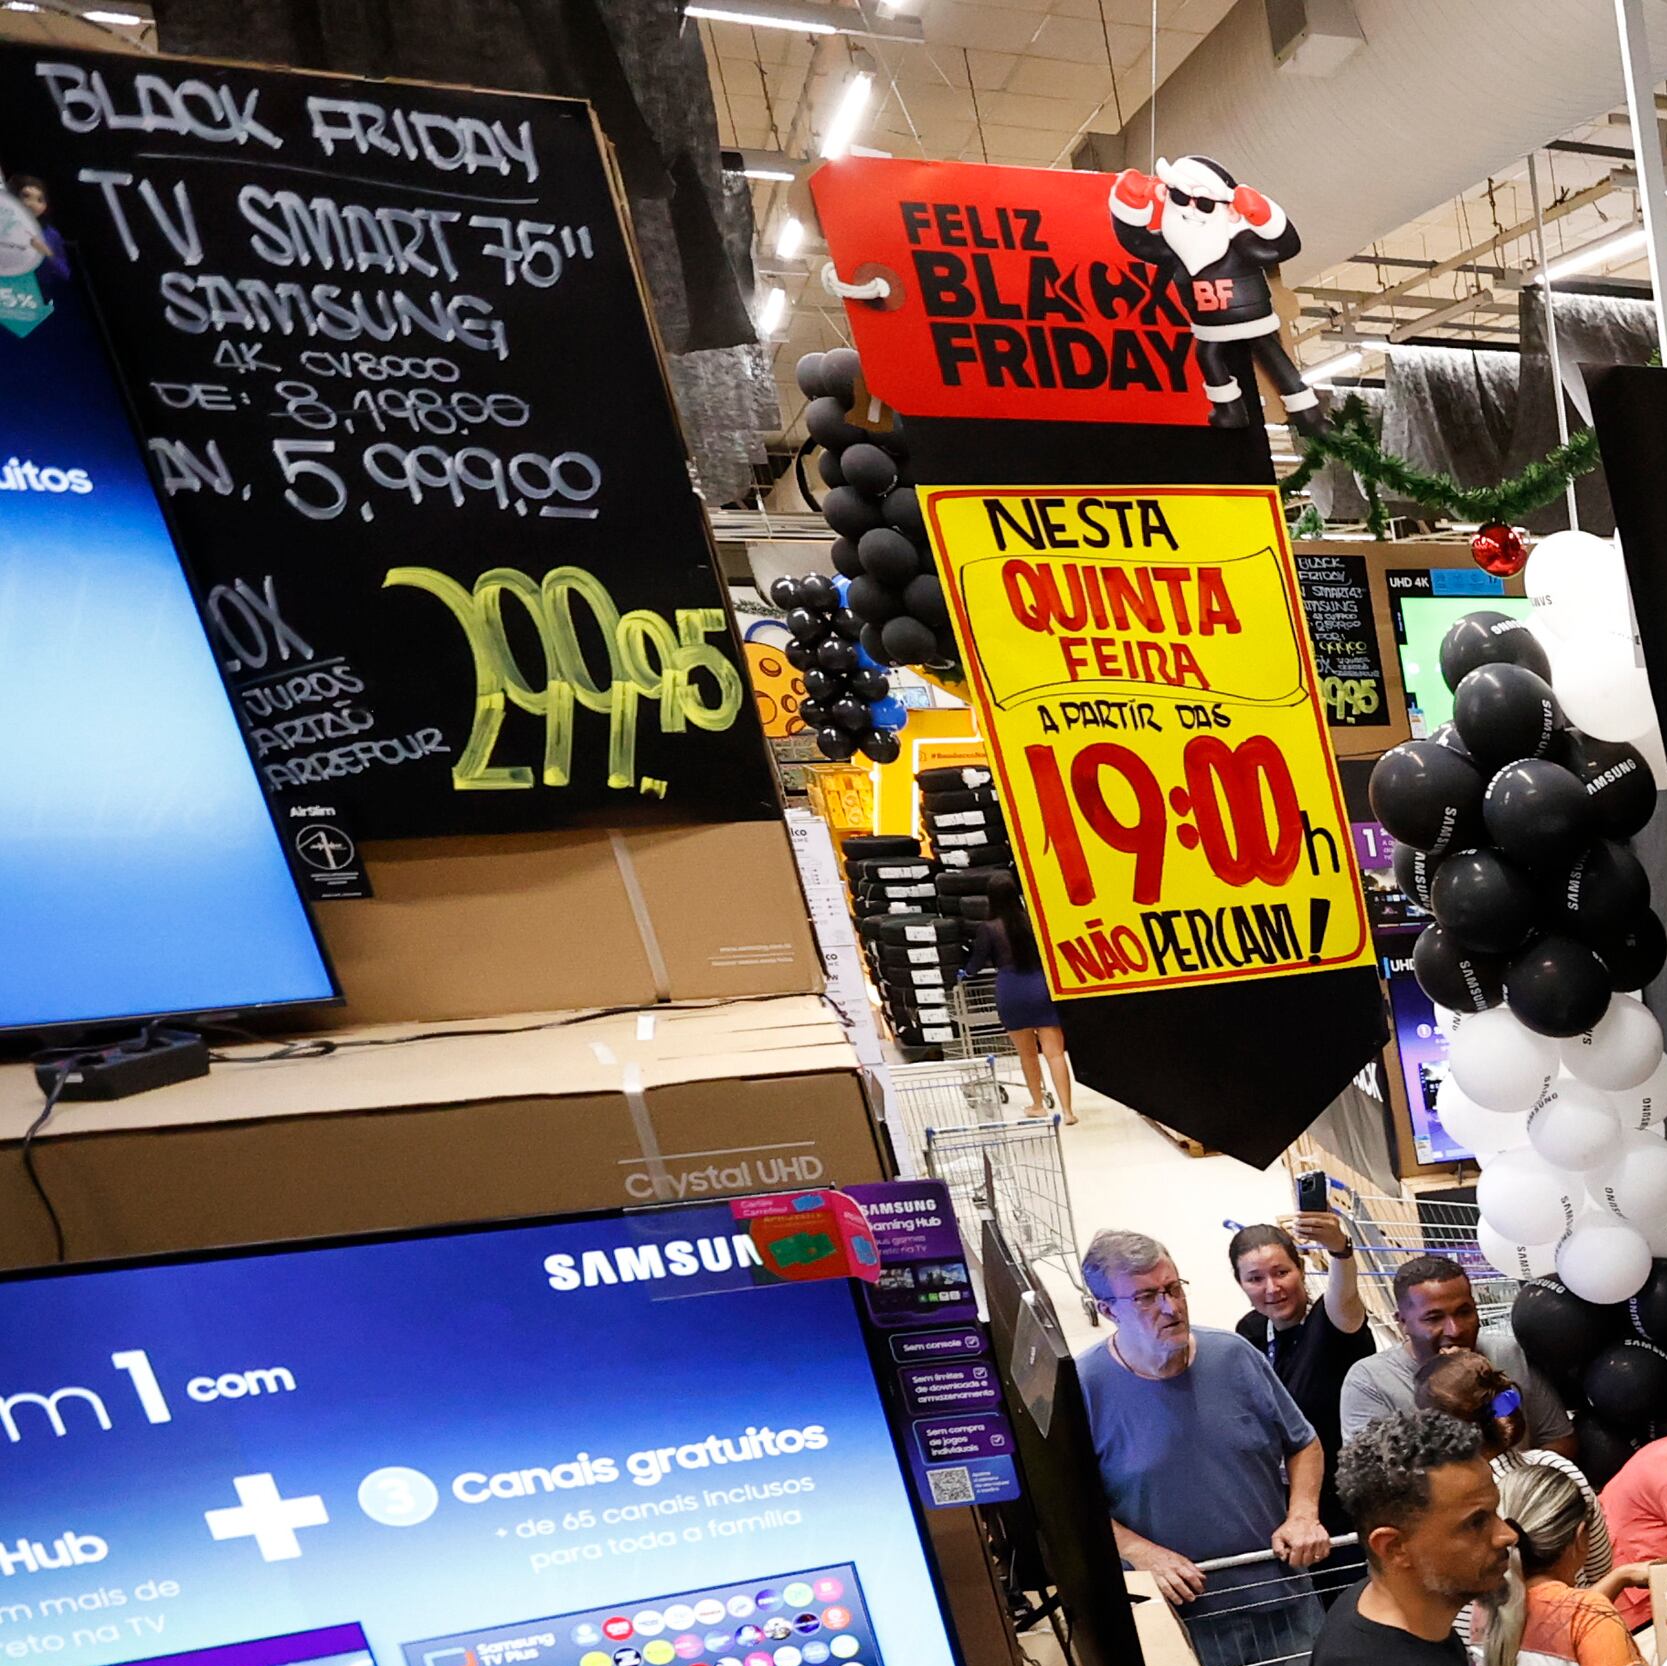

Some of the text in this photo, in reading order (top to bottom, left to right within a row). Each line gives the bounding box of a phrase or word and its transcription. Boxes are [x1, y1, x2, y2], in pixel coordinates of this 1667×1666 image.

[36, 62, 541, 182] BLACK FRIDAY
[77, 168, 205, 266] TV
[238, 185, 462, 281] SMART
[900, 201, 1049, 252] FELIZ
[910, 250, 1193, 328] BLACK
[1193, 279, 1236, 312] BF
[160, 272, 509, 361] SAMSUNG
[928, 321, 1195, 393] FRIDAY
[983, 497, 1179, 551] NESTA
[1001, 559, 1243, 637] QUINTA
[1389, 577, 1430, 588] UHD 4K
[1060, 636, 1210, 691] FEIRA
[1042, 703, 1055, 733] A
[1179, 703, 1232, 729] DAS
[289, 804, 336, 819] AirSlim
[1362, 828, 1378, 858] 1
[1056, 918, 1150, 984] NÃO
[624, 1154, 824, 1198] Crystal UHD
[861, 1199, 937, 1216] SAMSUNG
[915, 1216, 942, 1229] Hub
[110, 1348, 297, 1425] 1 com
[451, 1421, 829, 1507] Canais gratuitos
[515, 1471, 817, 1540] de 65 canais inclusos
[1, 1531, 109, 1579] Hub
[528, 1505, 803, 1576] para toda a família
[43, 1576, 181, 1617] mais de
[58, 1613, 169, 1651] na TV
[476, 1632, 557, 1652] Samsung
[504, 1648, 540, 1663] Plus
